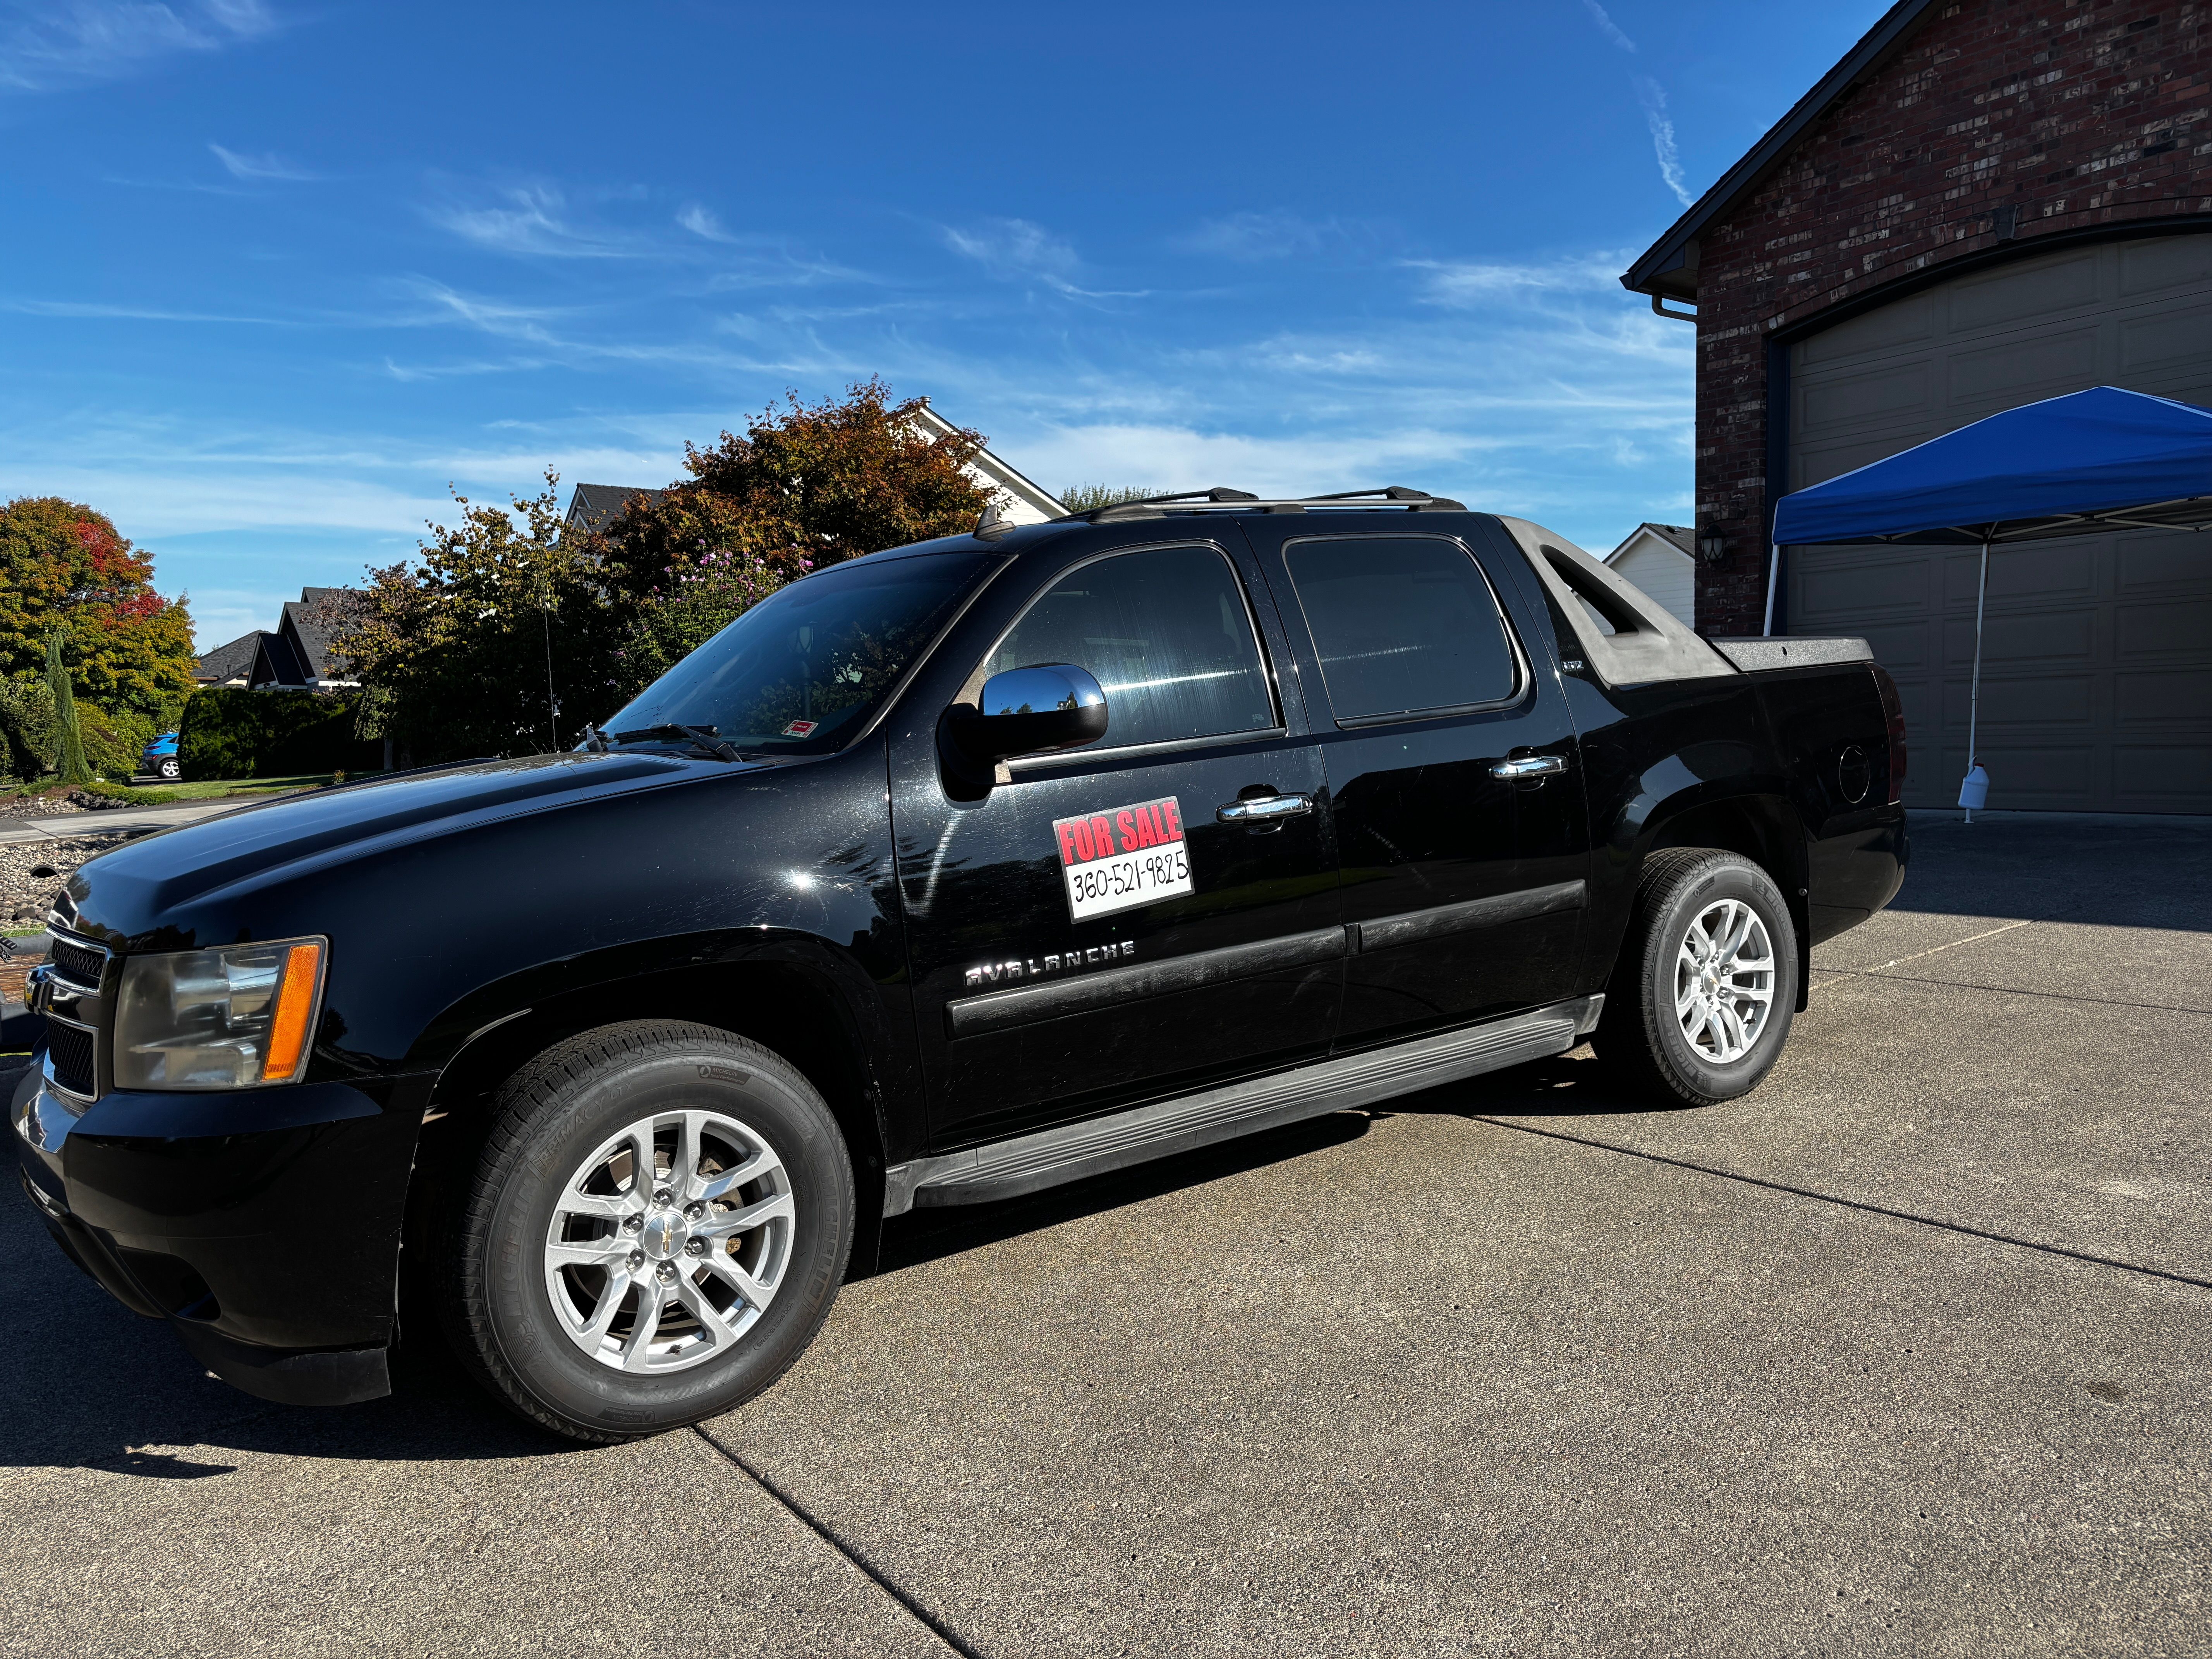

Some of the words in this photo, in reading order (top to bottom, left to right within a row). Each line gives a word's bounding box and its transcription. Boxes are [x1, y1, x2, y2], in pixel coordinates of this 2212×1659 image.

[1058, 816, 1114, 864] FOR
[1117, 801, 1183, 852] SALE
[1074, 850, 1189, 902] 360-521-9825
[965, 941, 1135, 986] AVALANCHE
[713, 1068, 738, 1077] MICHELIN
[538, 1096, 605, 1168] PRIMACY
[609, 1081, 632, 1101] LTX
[500, 1176, 539, 1317] MICHELIN
[809, 1176, 838, 1300] MICHELIN
